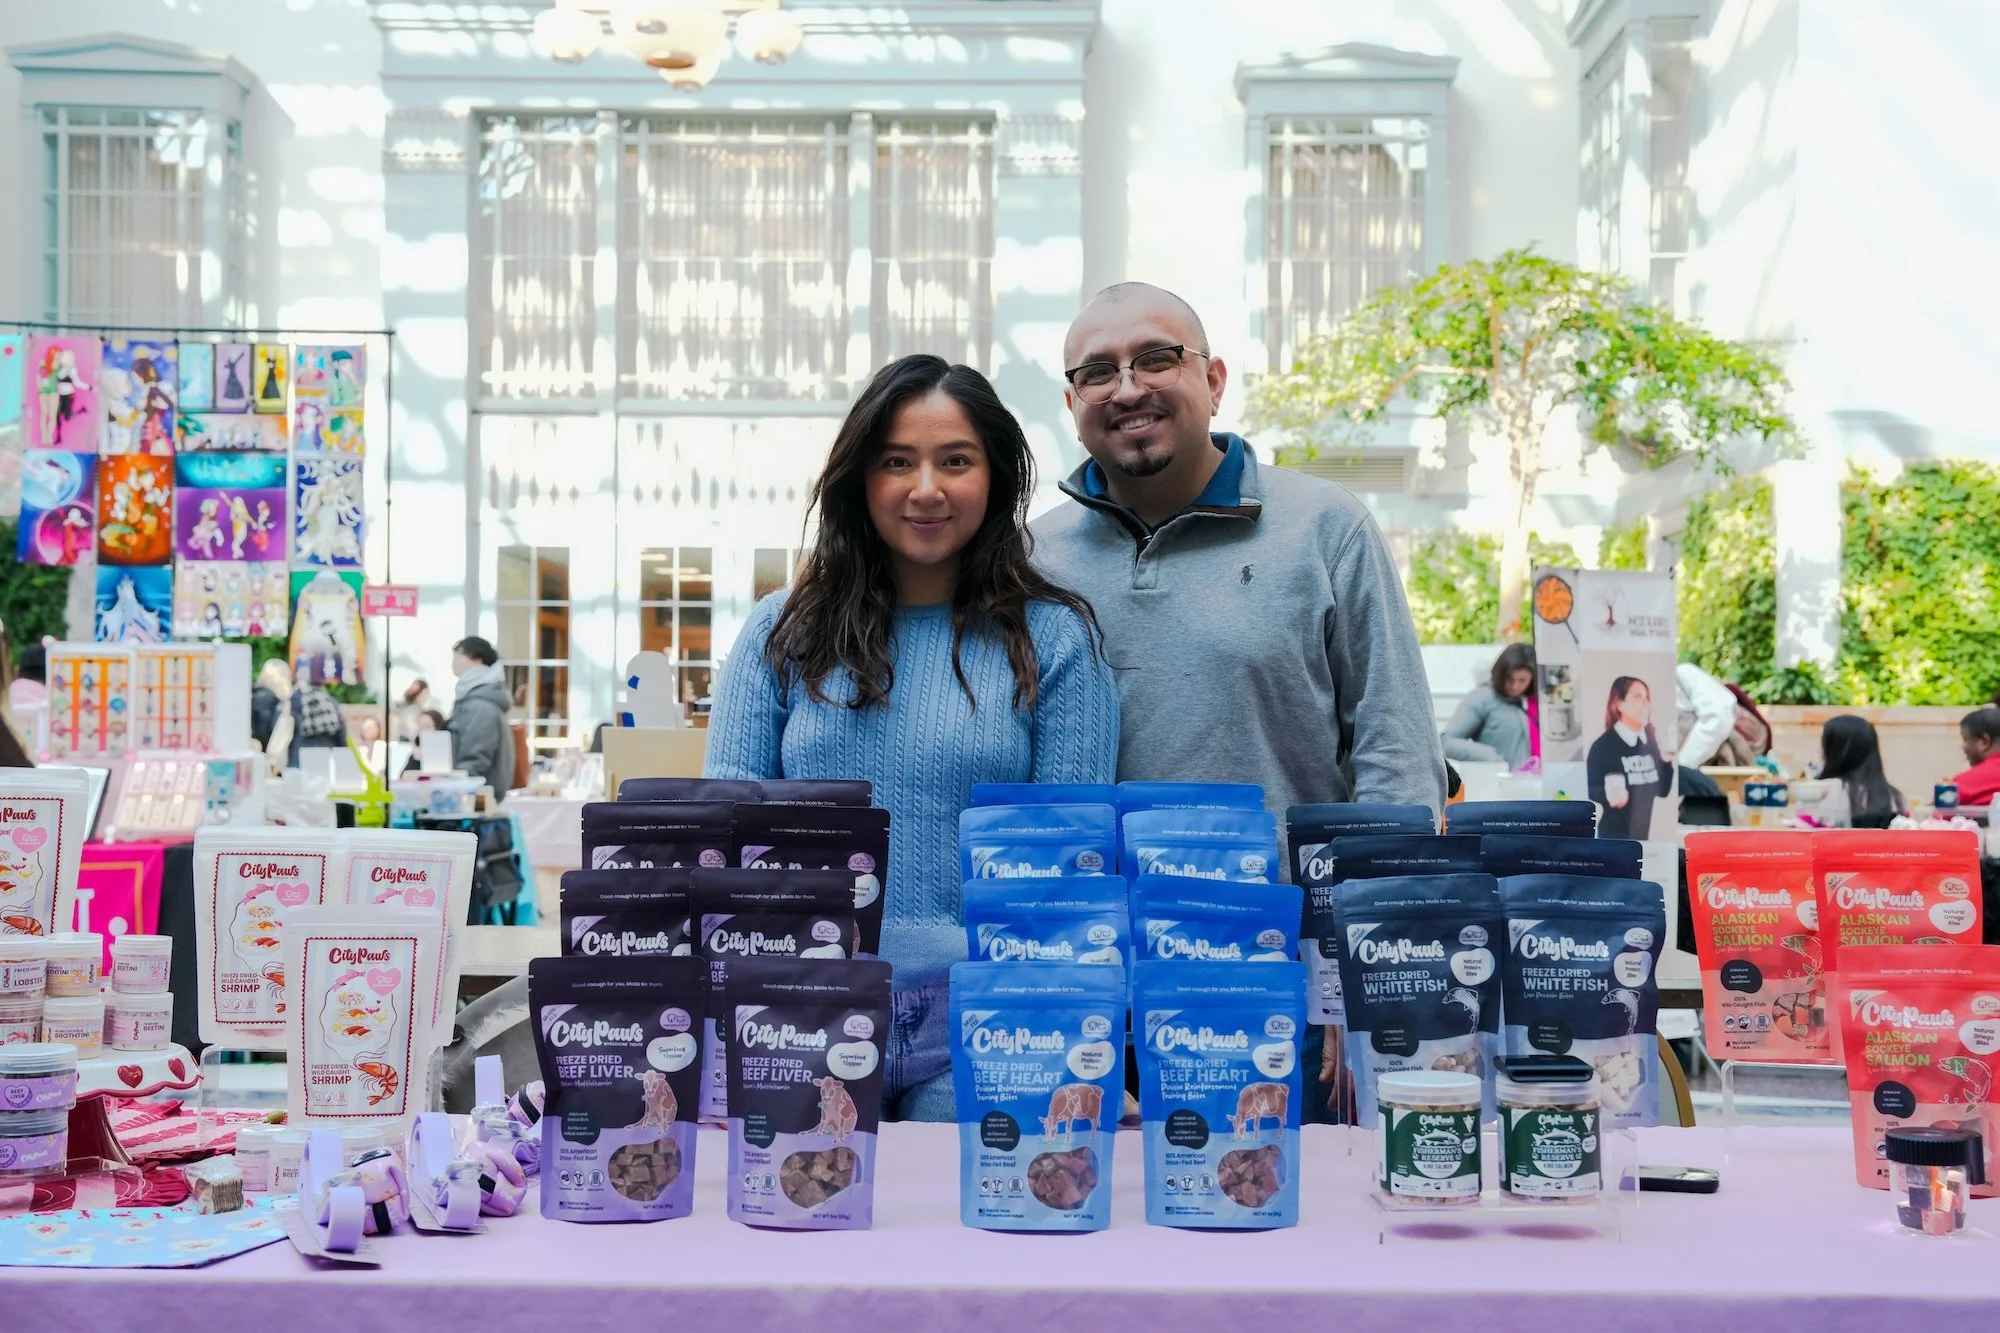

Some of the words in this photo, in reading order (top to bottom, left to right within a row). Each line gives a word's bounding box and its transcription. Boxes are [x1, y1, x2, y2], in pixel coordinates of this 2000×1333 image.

[239, 862, 299, 879] CityPaws
[371, 867, 428, 884] CityPaws
[1707, 886, 1792, 911] CityPaws
[1837, 886, 1925, 910] CityPaws
[1711, 913, 1779, 925] ALASKAN
[1840, 914, 1910, 926] ALASKAN
[1712, 926, 1756, 935] SOCKEYE
[1840, 928, 1885, 936] SOCKEYE
[582, 931, 669, 956] CityPaws
[710, 928, 796, 956] CityPaws
[1714, 934, 1774, 946] SALMON
[1840, 936, 1904, 945] SALMON
[990, 937, 1073, 962] CityPaws
[1157, 934, 1242, 960] CityPaws
[1359, 938, 1445, 965] CityPaws
[1520, 933, 1609, 961] CityPaws
[329, 947, 391, 965] CityPaws
[1362, 972, 1398, 981] FREEZE
[1399, 970, 1430, 980] DRIED
[1522, 967, 1556, 977] FREEZE
[1558, 968, 1591, 978] DRIED
[14, 976, 43, 987] LOBSTER
[1363, 980, 1413, 995] WHITE
[1415, 979, 1448, 992] FISH
[1523, 977, 1571, 991] WHITE
[1573, 978, 1609, 992] FISH
[221, 984, 260, 993] SHRIMP
[1861, 1001, 1956, 1029] CityPaws
[550, 1020, 644, 1048] CityPaws
[742, 1021, 828, 1050] CityPaws
[1156, 1024, 1249, 1051] CityPaws
[1866, 1031, 1938, 1044] ALASKAN
[972, 1027, 1065, 1056] CityPaws
[1865, 1044, 1911, 1054] SOCKEYE
[556, 1055, 587, 1065] FREEZE
[589, 1055, 622, 1064] DRIED
[742, 1057, 770, 1067] FREEZE
[771, 1058, 803, 1068] DRIED
[839, 1053, 866, 1061] Superfood
[1866, 1054, 1930, 1067] SALMON
[972, 1061, 1008, 1071] FREEZE
[1010, 1062, 1043, 1072] DRIED
[1158, 1059, 1194, 1069] FREEZE
[1195, 1059, 1228, 1068] DRIED
[558, 1066, 586, 1078] BEEF
[590, 1065, 634, 1078] LIVER
[742, 1067, 767, 1081] BEEF
[771, 1068, 813, 1083] LIVER
[973, 1071, 1008, 1084] BEEF
[1011, 1071, 1063, 1084] HEART
[1160, 1069, 1194, 1082] BEEF
[1197, 1069, 1249, 1082] HEART
[312, 1076, 352, 1085] SHRIMP
[1184, 1083, 1237, 1092] Reinforcement
[1162, 1092, 1186, 1101] Training
[1187, 1092, 1206, 1100] Bites
